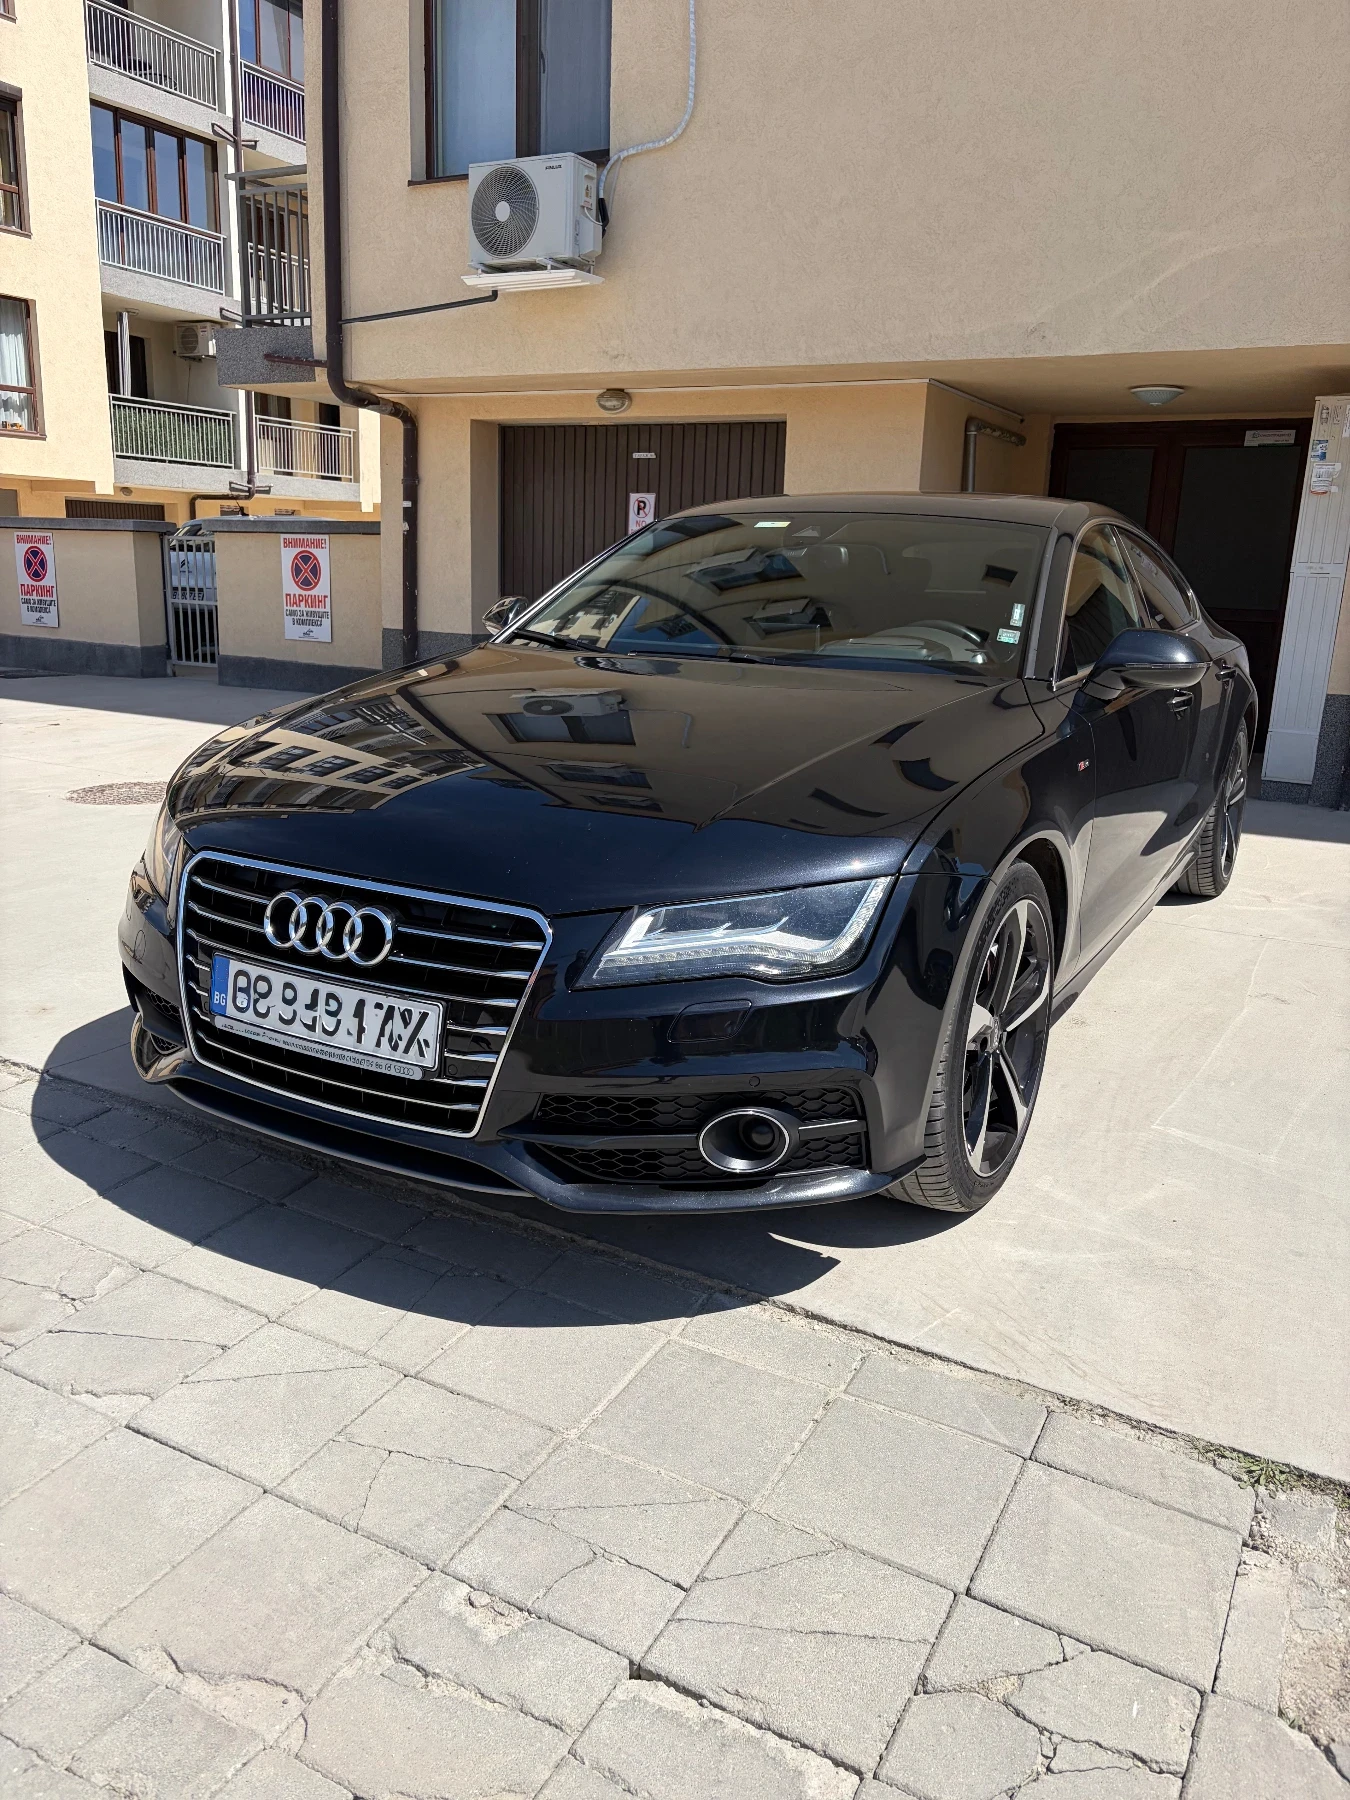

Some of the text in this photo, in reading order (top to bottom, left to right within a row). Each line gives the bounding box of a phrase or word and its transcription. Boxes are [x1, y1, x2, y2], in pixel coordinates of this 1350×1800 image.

[16, 534, 51, 545] ВНИМАНИЕ!
[283, 537, 327, 549] ВНИМАНИЕ!
[20, 584, 54, 598] ПАРКИНГ
[285, 593, 329, 609] ПАРКИНГ
[298, 609, 305, 617] ЗА
[213, 991, 226, 1006] BG
